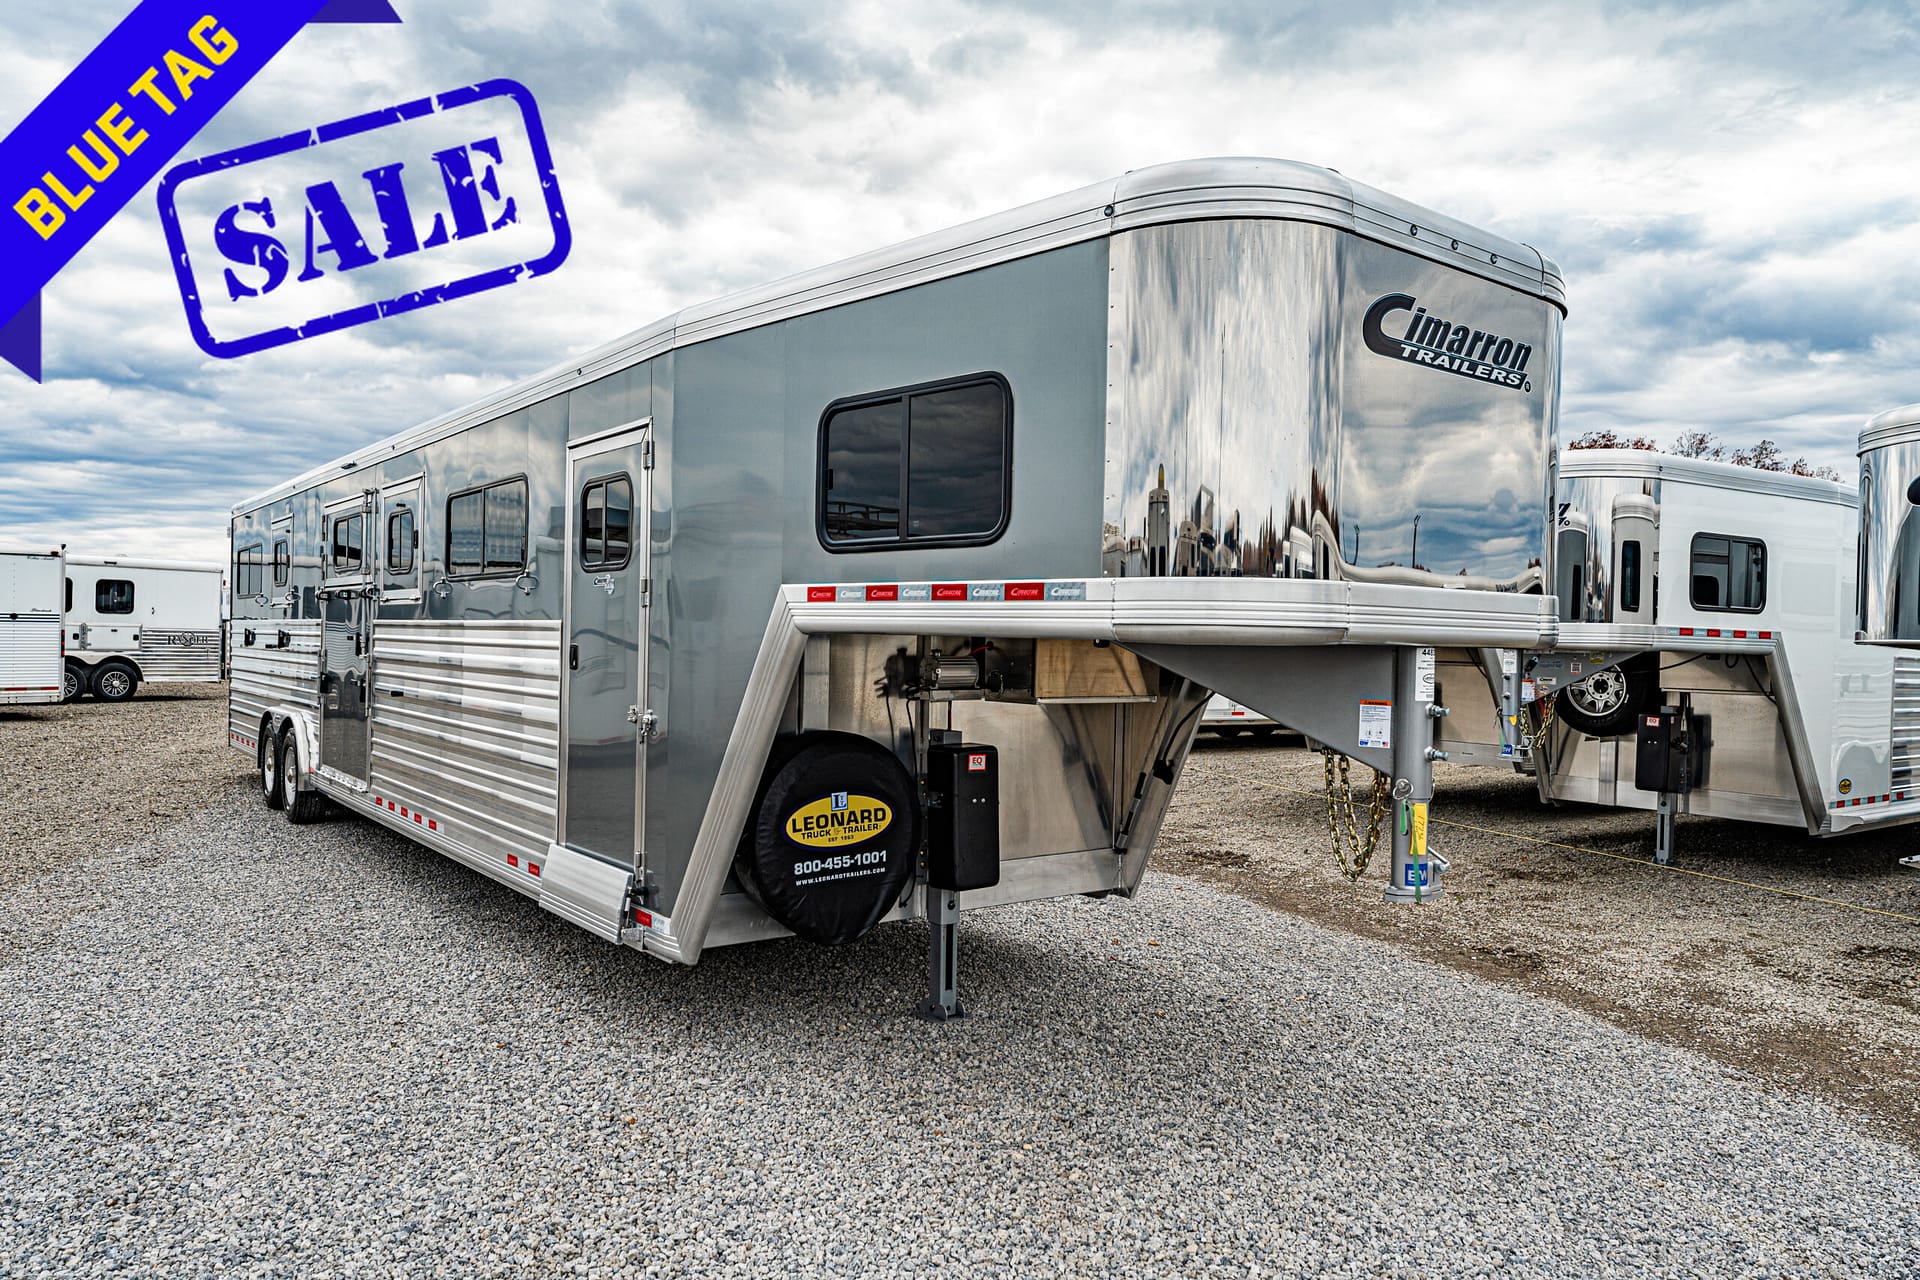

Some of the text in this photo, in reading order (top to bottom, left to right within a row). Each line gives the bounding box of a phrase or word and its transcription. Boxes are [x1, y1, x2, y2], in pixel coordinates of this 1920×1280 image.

[1363, 293, 1532, 372] Cimarron
[1401, 343, 1522, 387] TRAILERS
[971, 756, 983, 766] EQ
[791, 807, 887, 833] LEONARD
[801, 829, 831, 840] TRUCK
[842, 823, 879, 834] TRAILER
[793, 850, 887, 875] 800-455-1001
